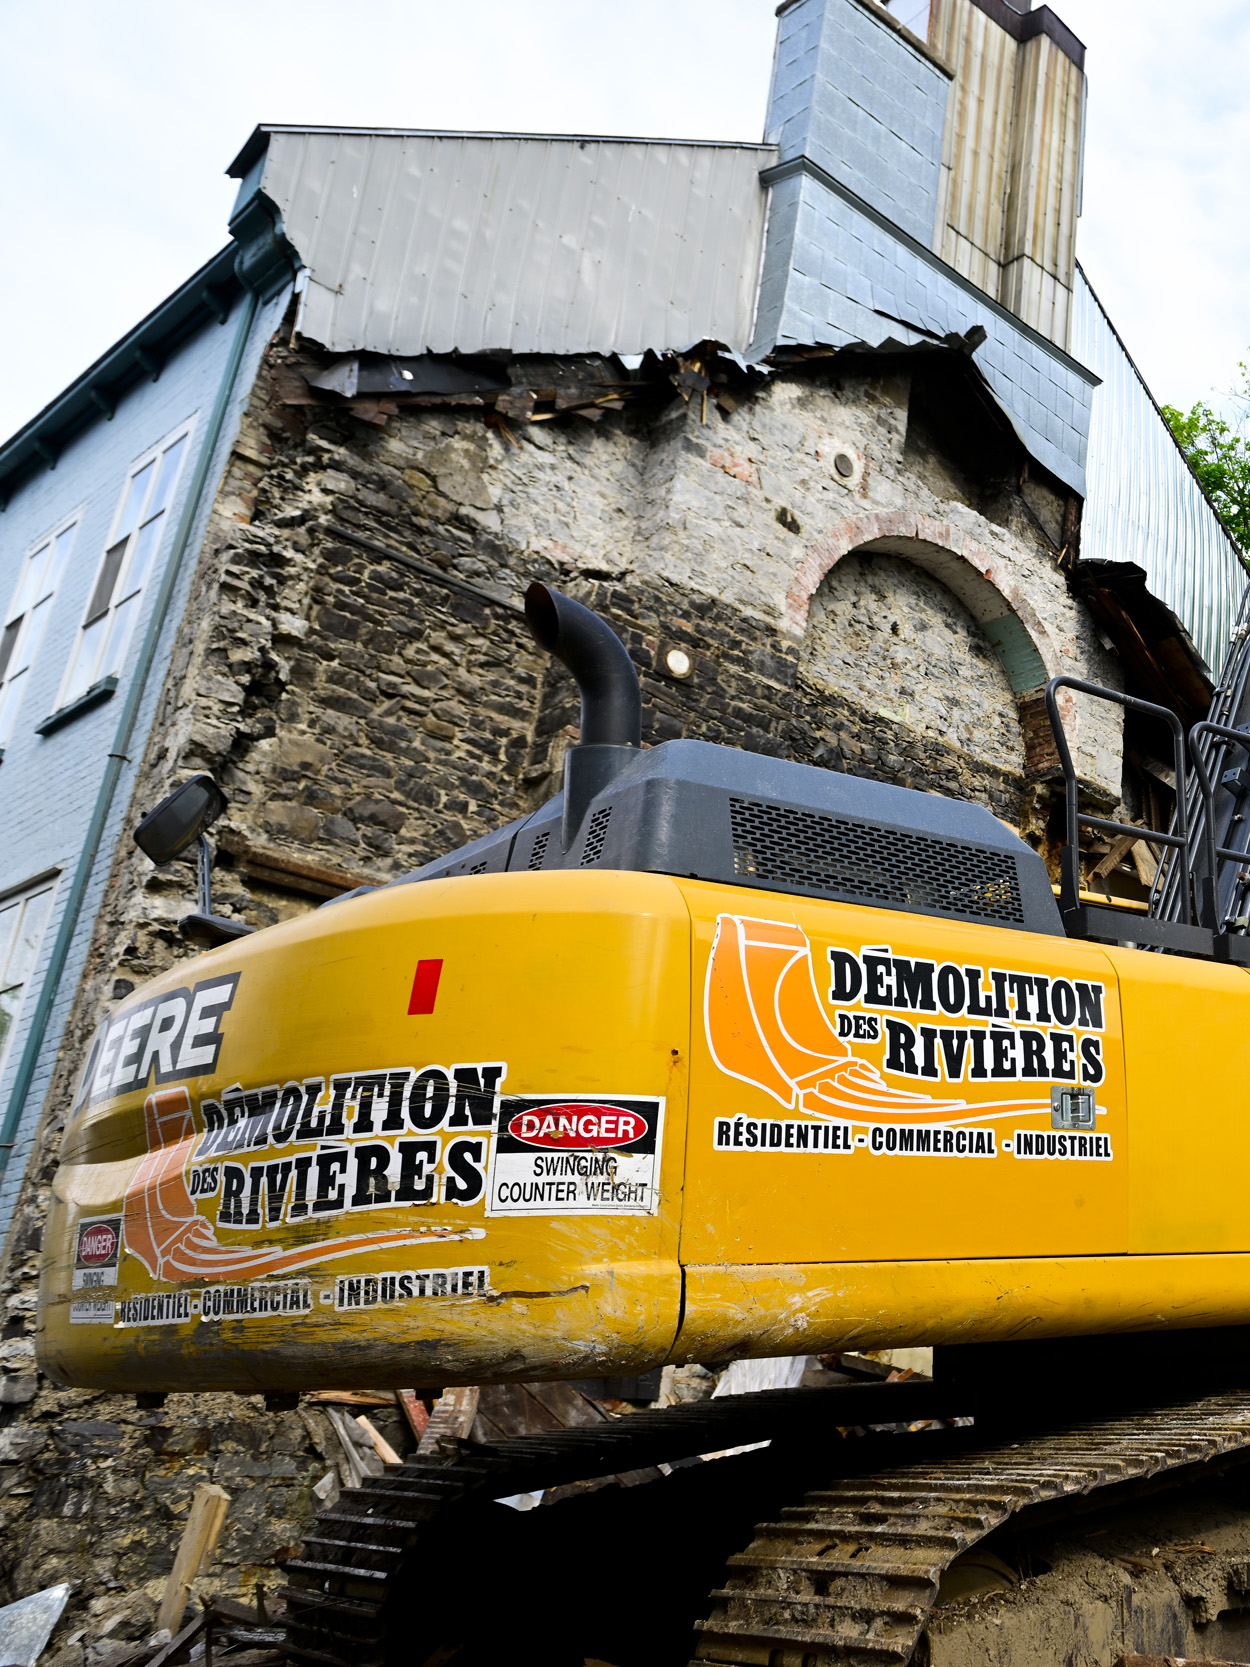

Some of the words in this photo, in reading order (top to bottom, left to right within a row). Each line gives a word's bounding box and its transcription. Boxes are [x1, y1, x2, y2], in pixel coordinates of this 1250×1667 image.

[830, 948, 1103, 1029] DÉMOLITION
[838, 1013, 879, 1039] DES
[885, 1019, 1103, 1083] RIVIÈRES
[199, 1065, 504, 1158] DÉMOLITION
[521, 1115, 636, 1138] DANGER
[717, 1117, 852, 1150] RÉSIDENTIEL
[871, 1127, 995, 1154] COMMERCIAL
[1016, 1133, 1111, 1158] INDUSTRIEL
[190, 1167, 219, 1196] DES
[217, 1139, 484, 1225] RIVIÈRES
[533, 1156, 619, 1177] SWINGING
[498, 1182, 577, 1203] COUNTER
[585, 1182, 648, 1203] WEIGHT
[81, 1234, 113, 1256] DANGER
[202, 1284, 312, 1317] COMMERCIAL
